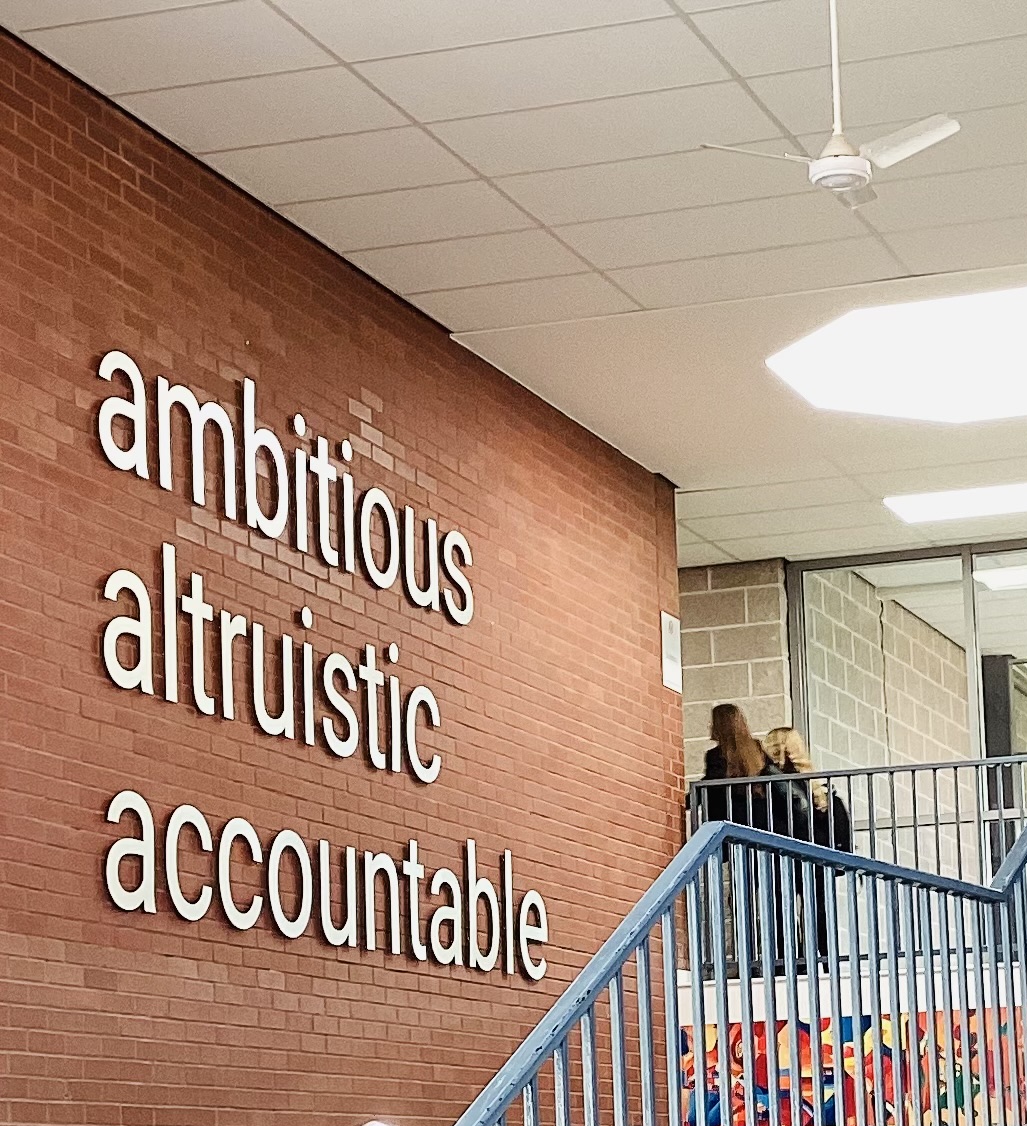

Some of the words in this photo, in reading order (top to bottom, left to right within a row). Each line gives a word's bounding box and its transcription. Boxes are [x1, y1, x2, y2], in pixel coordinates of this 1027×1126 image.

[97, 349, 475, 626] ambitious
[103, 542, 443, 784] altruistic
[106, 790, 549, 982] accountable
